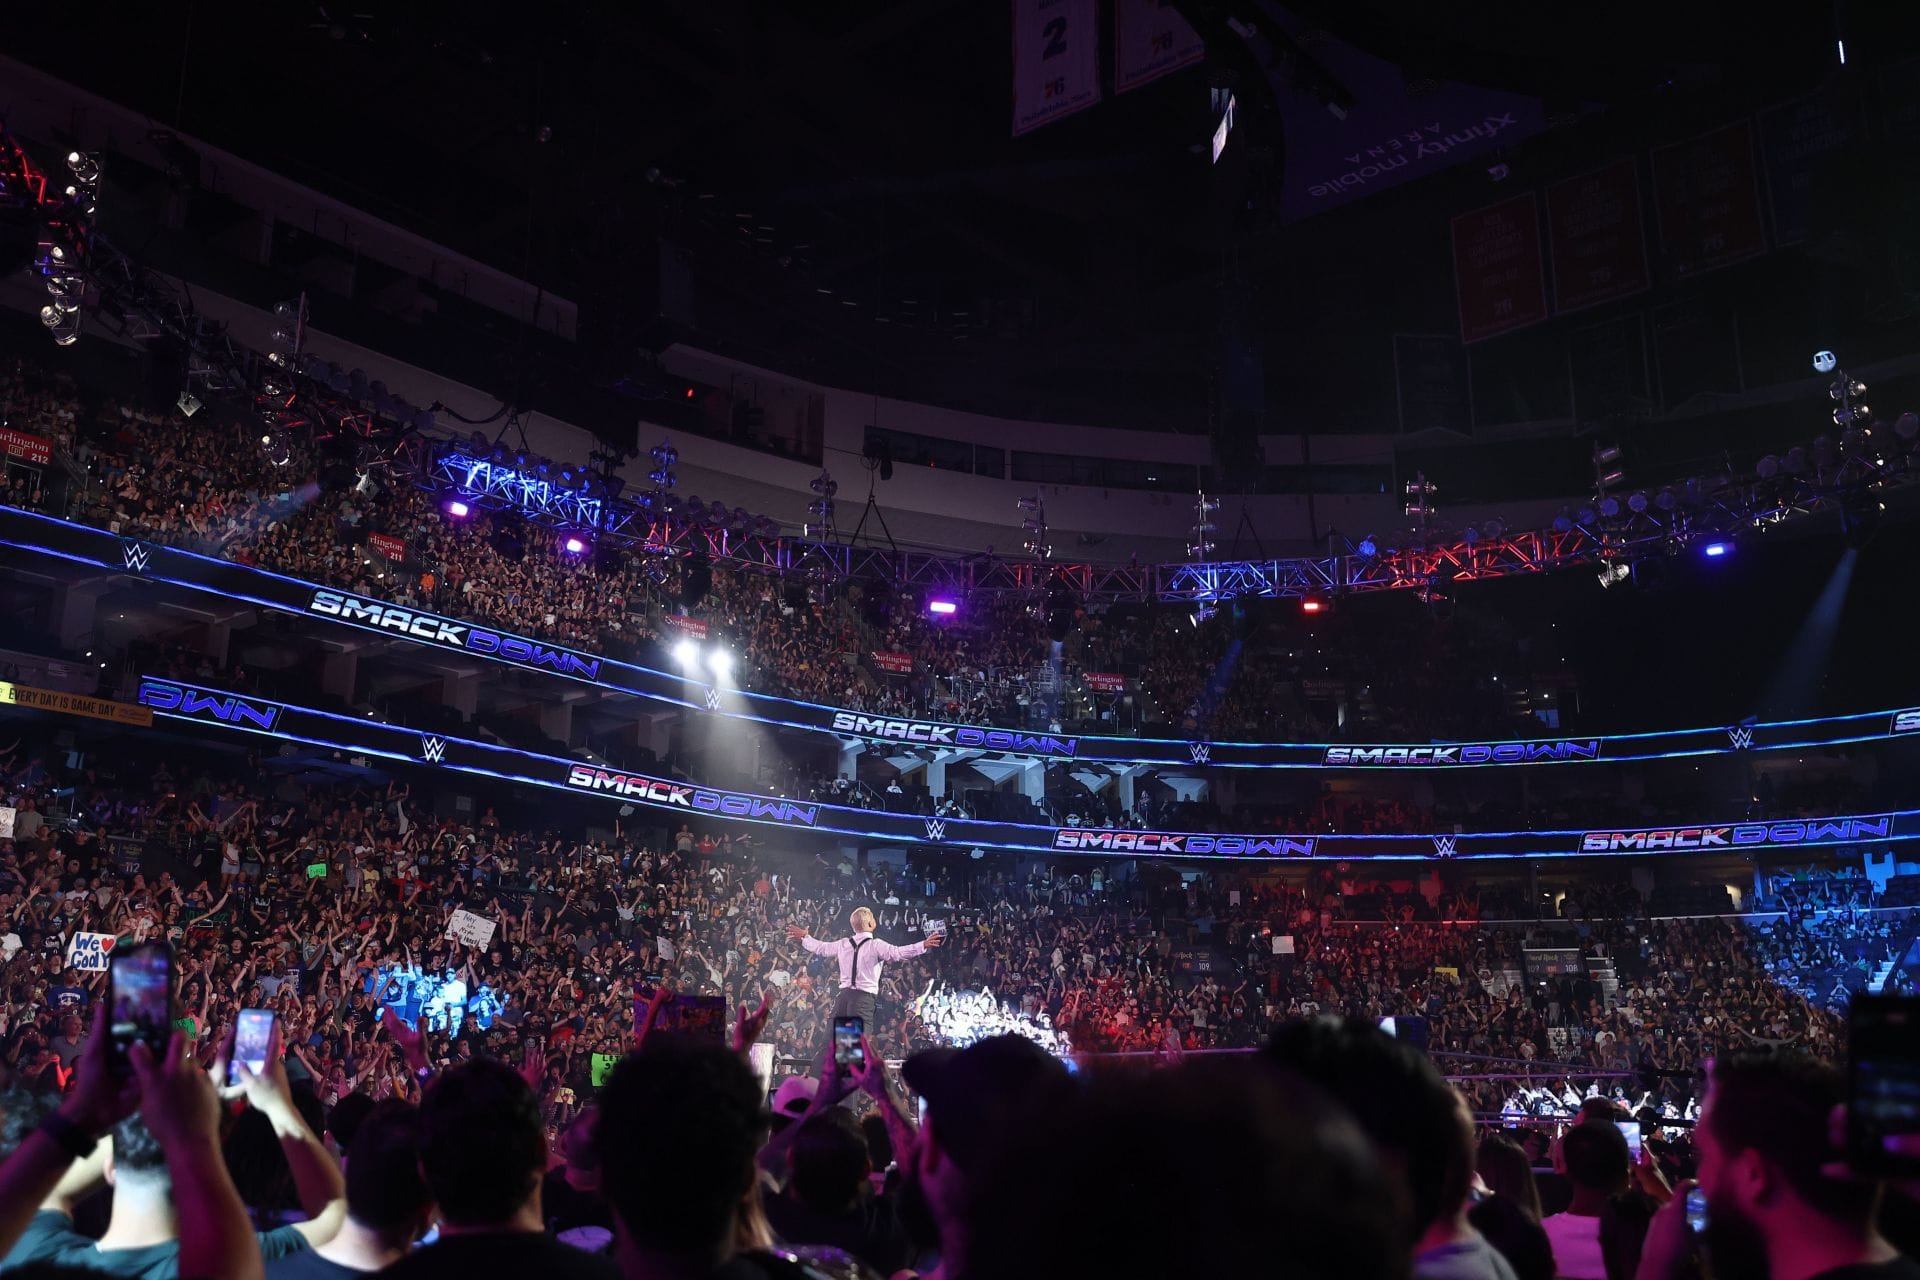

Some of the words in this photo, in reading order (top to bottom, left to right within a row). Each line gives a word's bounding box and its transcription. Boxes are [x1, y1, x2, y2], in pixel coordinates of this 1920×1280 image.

[1042, 16, 1067, 61] 2
[1343, 121, 1441, 164] ARENA
[1416, 112, 1518, 160] xfinity
[1306, 154, 1409, 197] mobile
[31, 453, 48, 465] 212
[390, 552, 402, 562] 211
[310, 590, 600, 680] SMACKDOWN
[8, 687, 40, 704] EVERY
[40, 692, 59, 706] DAY
[60, 695, 69, 709] IS
[71, 698, 97, 714] GAME
[98, 703, 115, 717] DAY
[832, 712, 1077, 755] SMACKDOWN
[1325, 740, 1599, 765] SMACKDOWN
[568, 766, 817, 825] SMACKDOWN
[1055, 831, 1314, 856] SMACKDOWN
[1582, 818, 1889, 851] SMACKDOWN
[76, 933, 101, 951] We
[1198, 962, 1210, 970] 109
